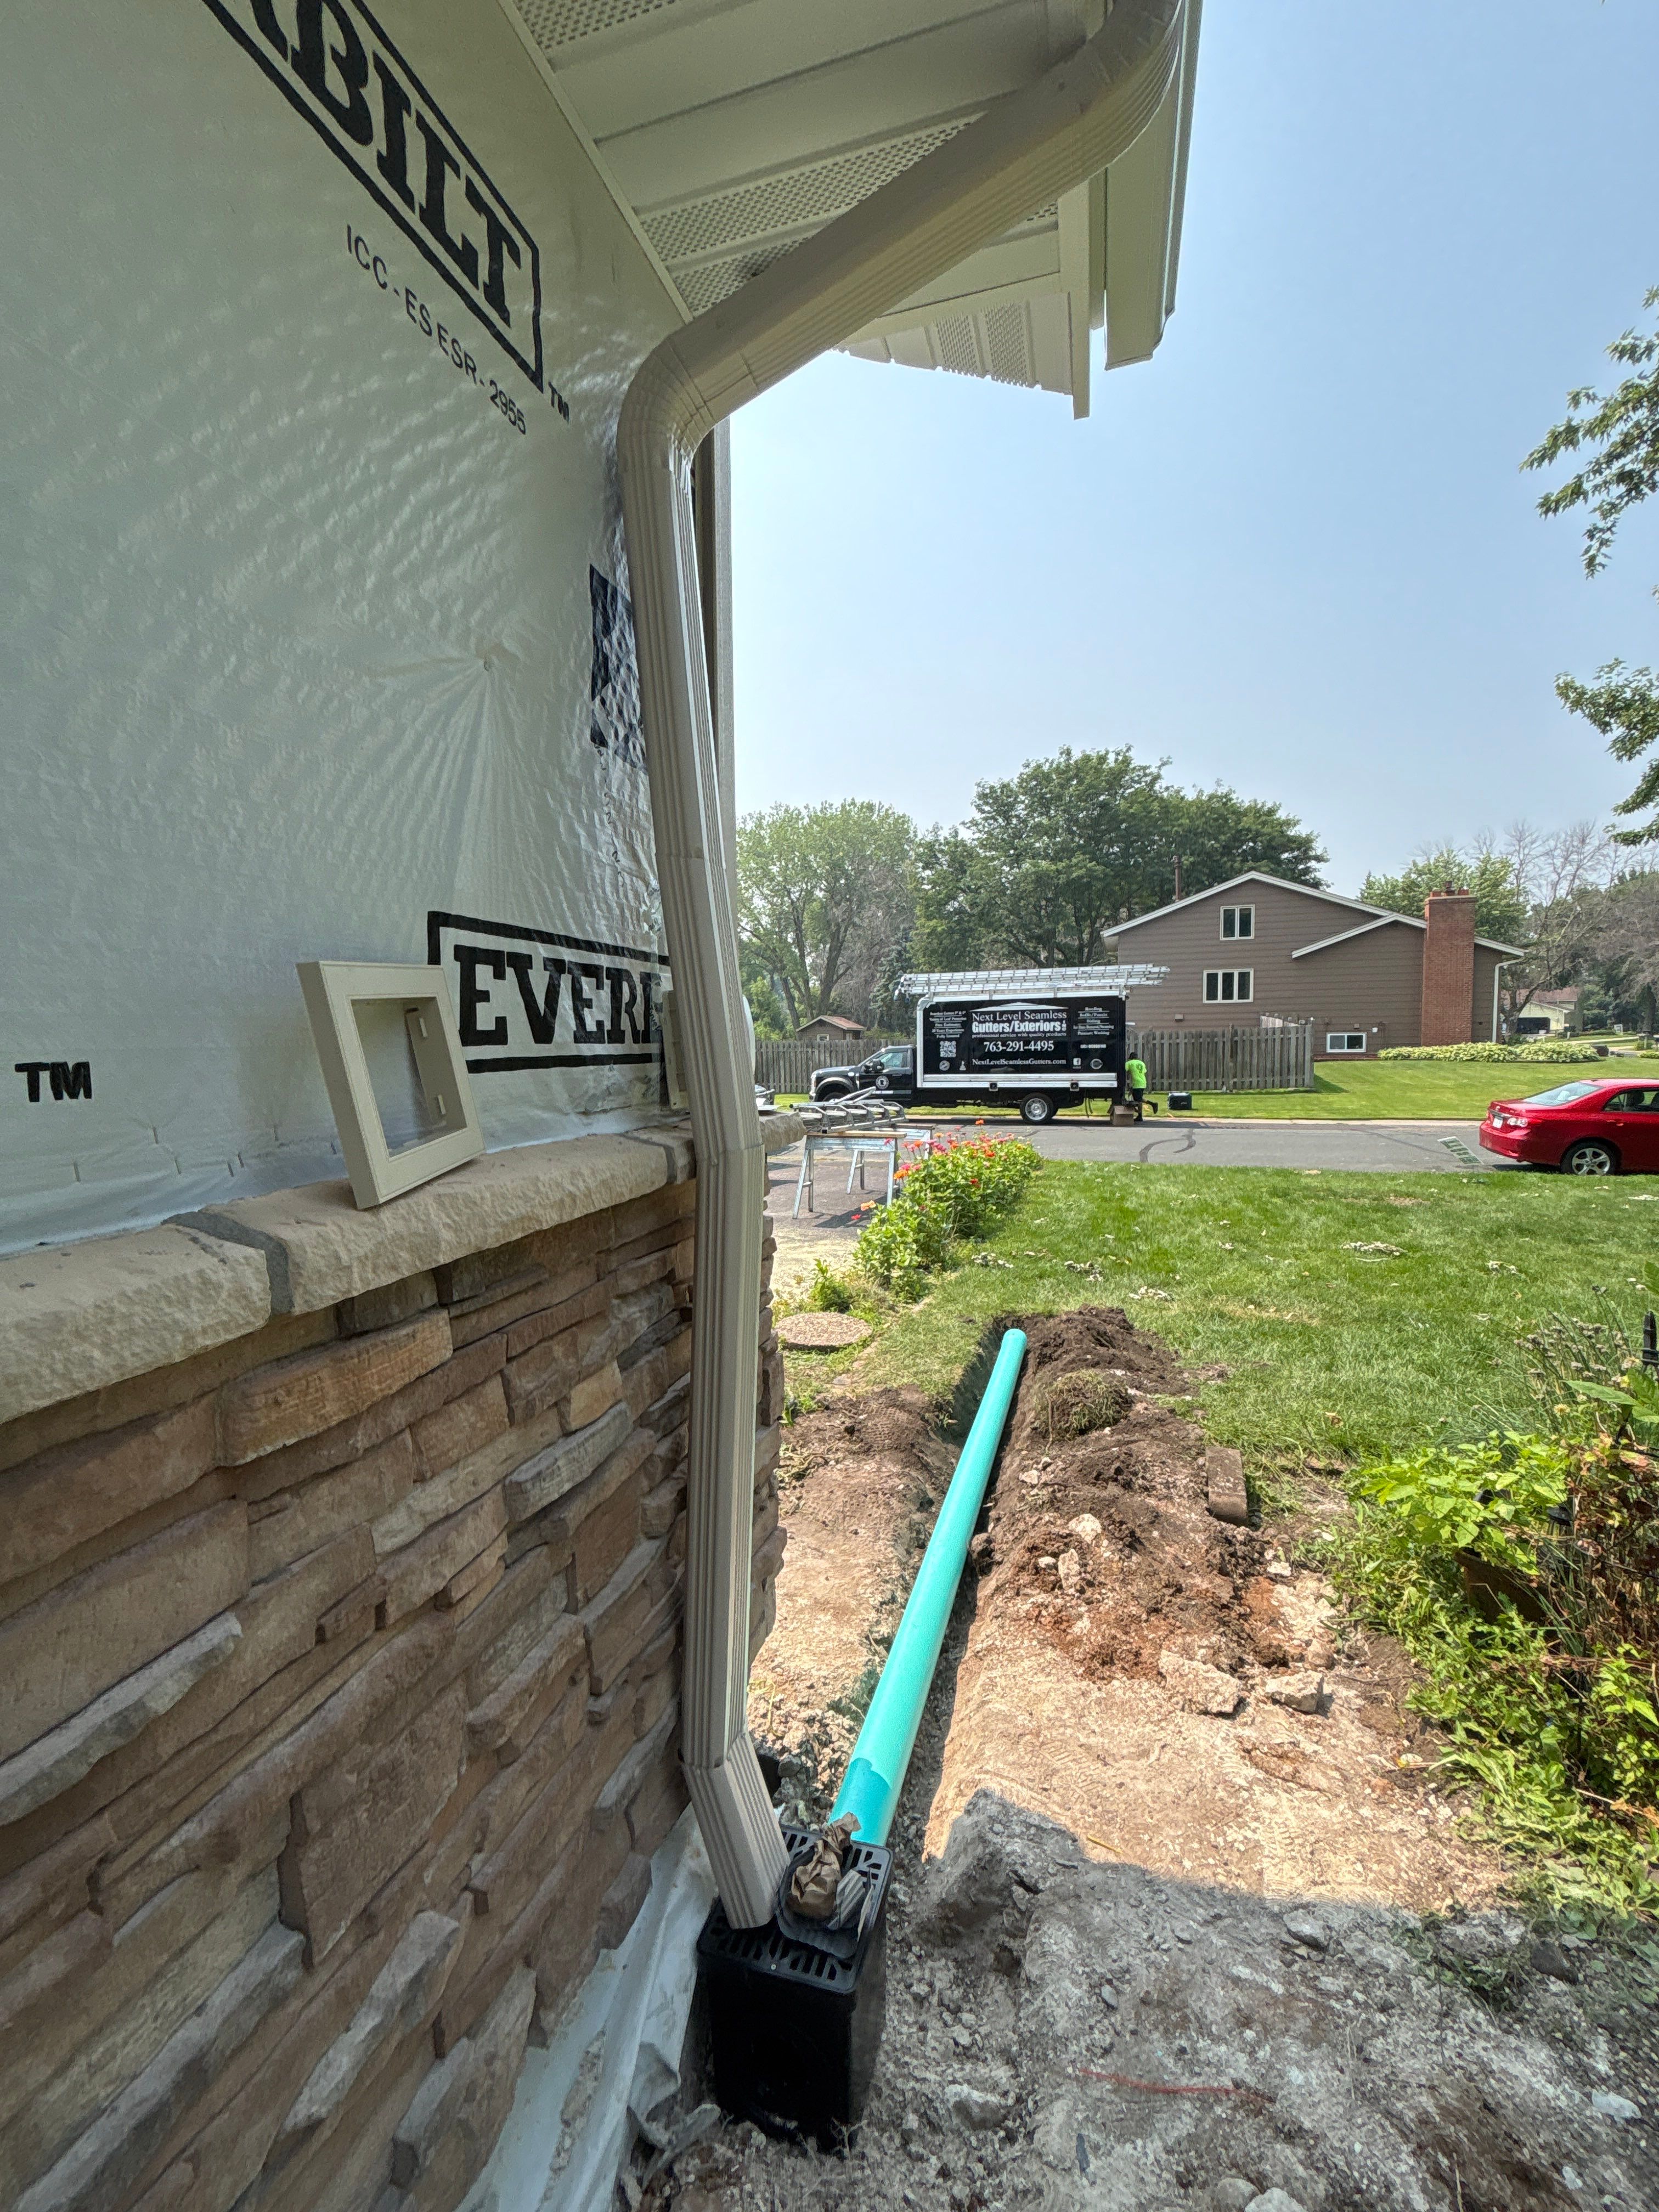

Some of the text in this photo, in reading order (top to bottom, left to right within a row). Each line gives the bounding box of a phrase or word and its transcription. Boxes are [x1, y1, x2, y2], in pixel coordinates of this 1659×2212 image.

[438, 323, 526, 436] ESR-2955
[549, 381, 569, 424] TM
[972, 1012, 994, 1021] Next
[996, 1011, 1021, 1020] Level
[1024, 1010, 1067, 1019] Seamless
[972, 1020, 1061, 1033] Gutters/Exteriors
[983, 1040, 1054, 1052] 763-291-4495
[15, 1061, 93, 1103] TM
